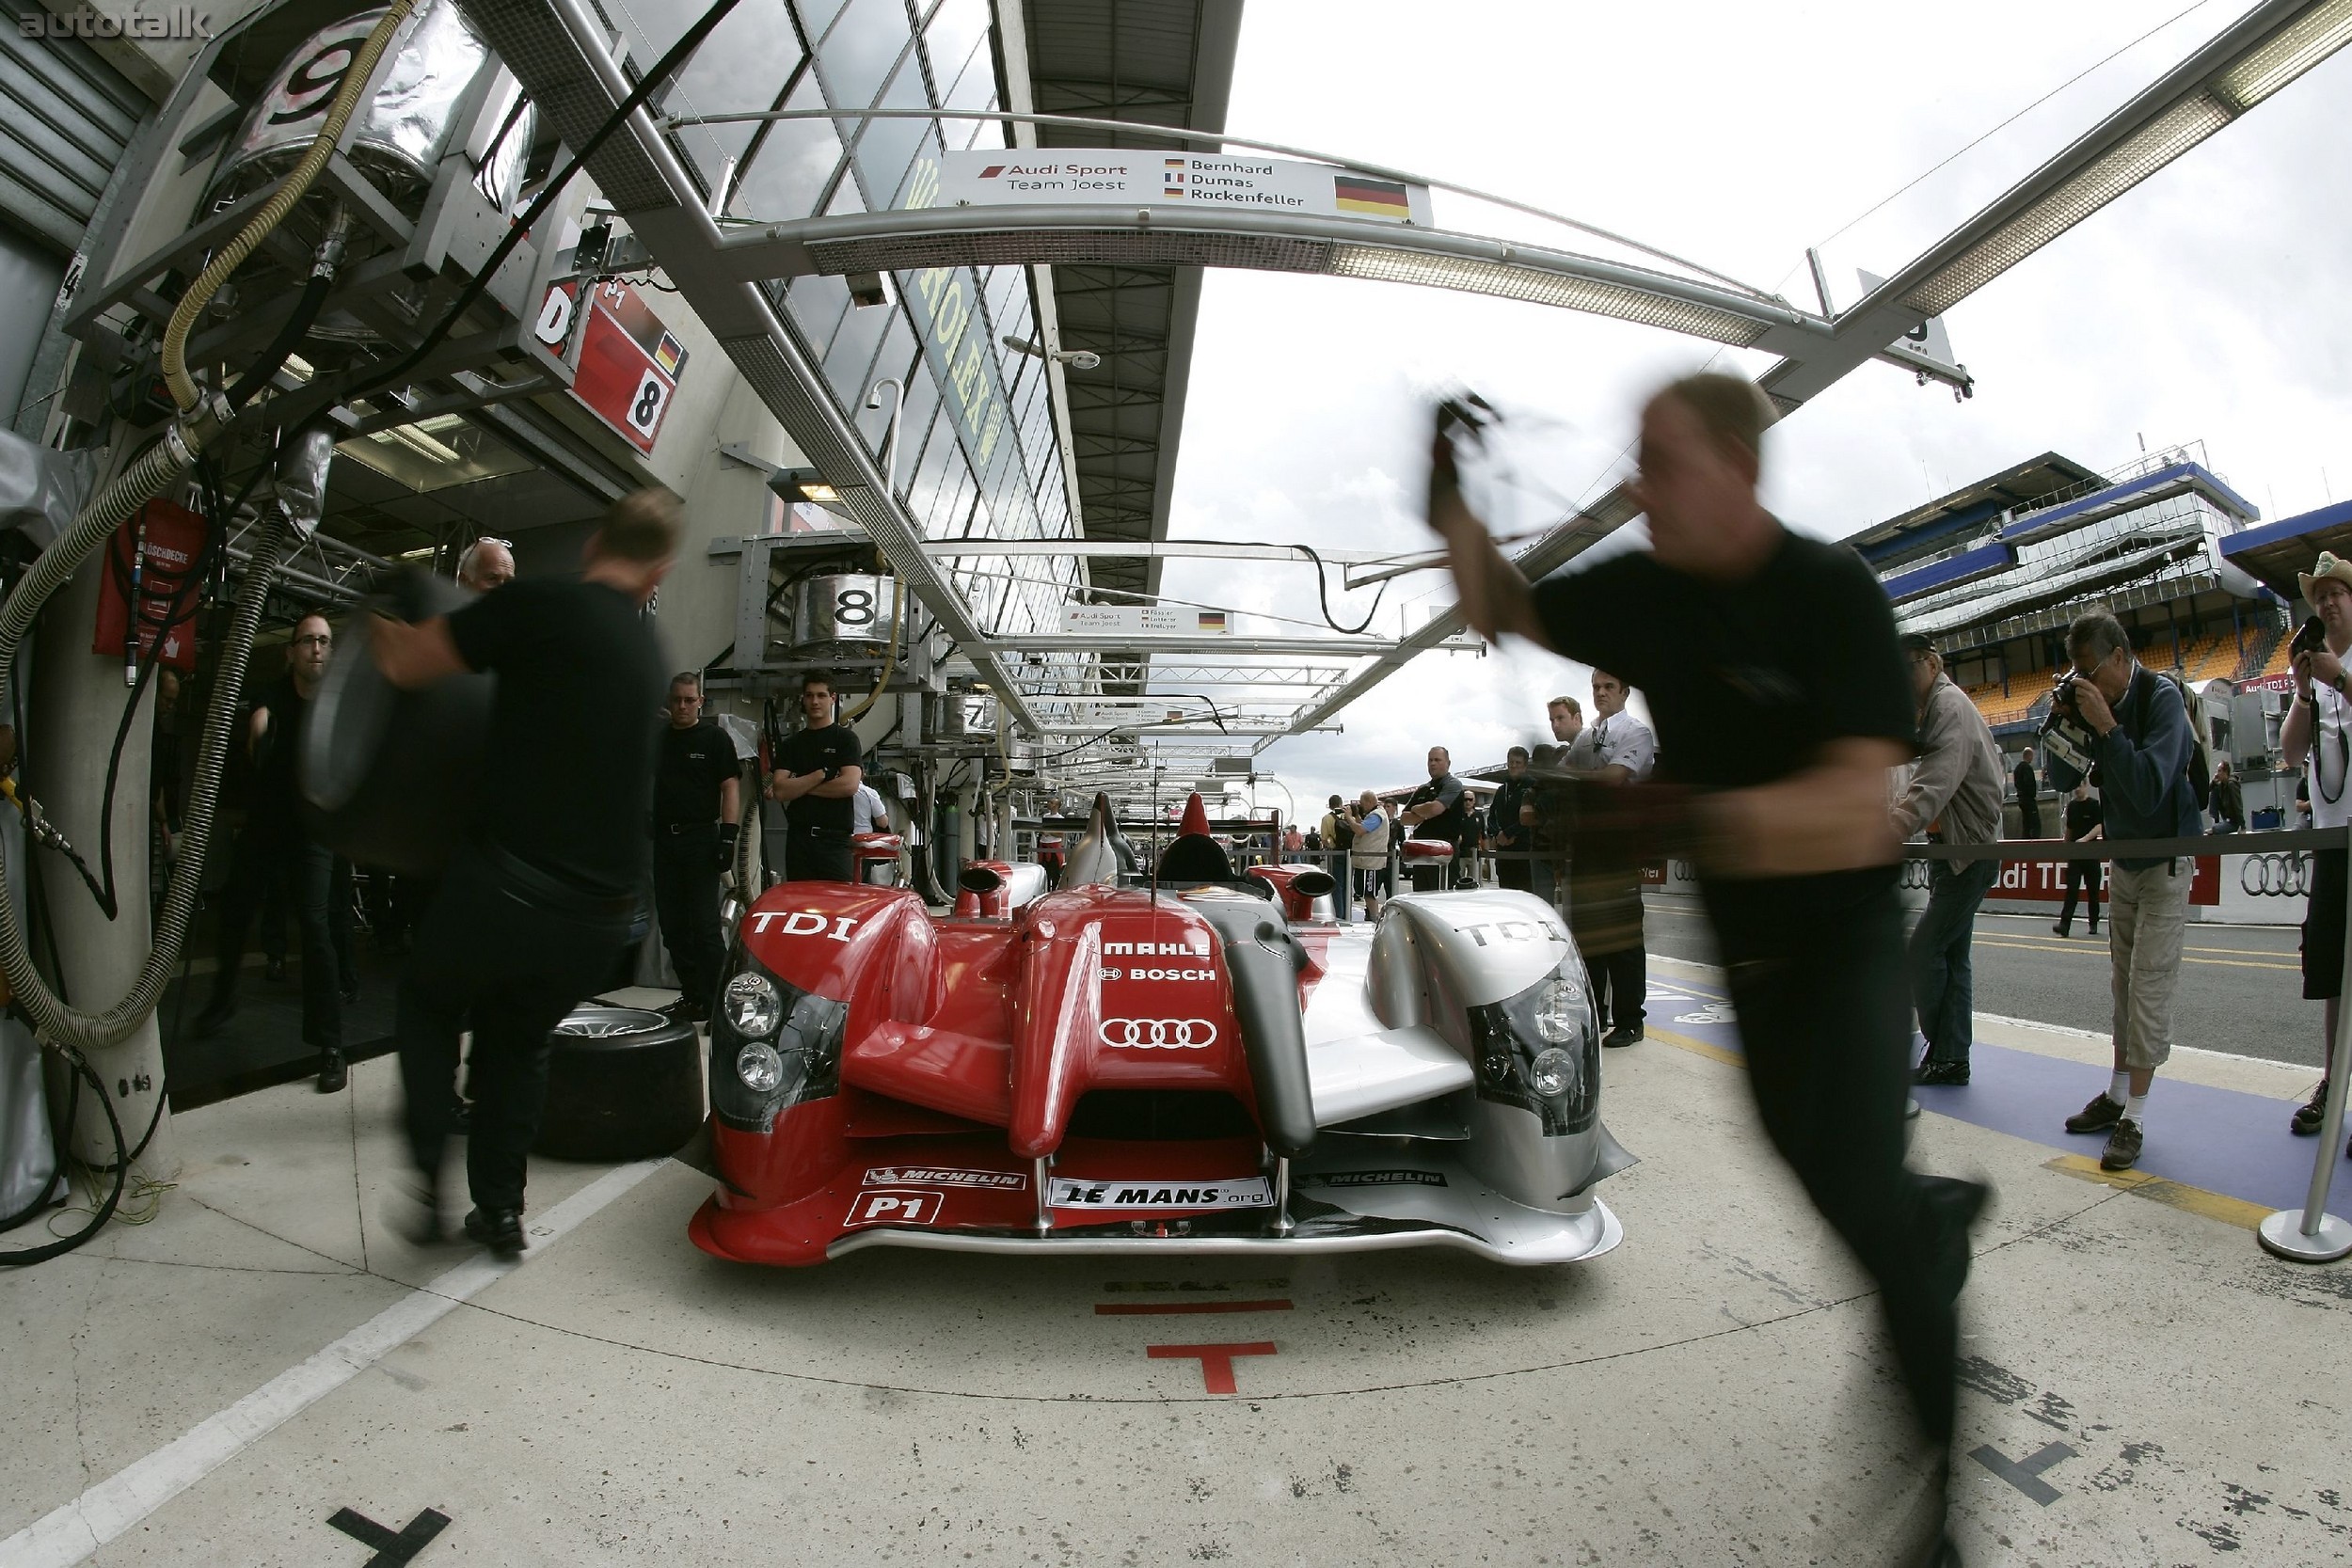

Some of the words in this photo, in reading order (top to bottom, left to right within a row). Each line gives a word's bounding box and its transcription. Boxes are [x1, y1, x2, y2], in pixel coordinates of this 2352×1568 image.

[1008, 165, 1064, 176] Audi
[1066, 164, 1129, 178] Sport
[1190, 160, 1274, 176] Bernhard
[1007, 179, 1065, 190] Team
[1071, 179, 1126, 191] Joest
[1190, 174, 1254, 189] Dumas
[1190, 188, 1305, 207] Rockenfeller
[534, 286, 573, 344] D
[635, 380, 661, 427] 8
[143, 542, 189, 565] LÖSCHDECKE
[834, 589, 875, 626] 8
[2246, 683, 2265, 694] Audi
[2266, 679, 2283, 690] TDI
[964, 704, 984, 726] 7
[751, 911, 859, 942] TDI
[1454, 920, 1568, 947] TDI
[1104, 942, 1210, 956] MAHLE
[1130, 968, 1216, 981] BOSCH
[901, 1169, 1020, 1185] MICHELIN
[1329, 1173, 1441, 1183] MICHELIN
[1066, 1187, 1106, 1204] LE
[864, 1197, 924, 1219] P1
